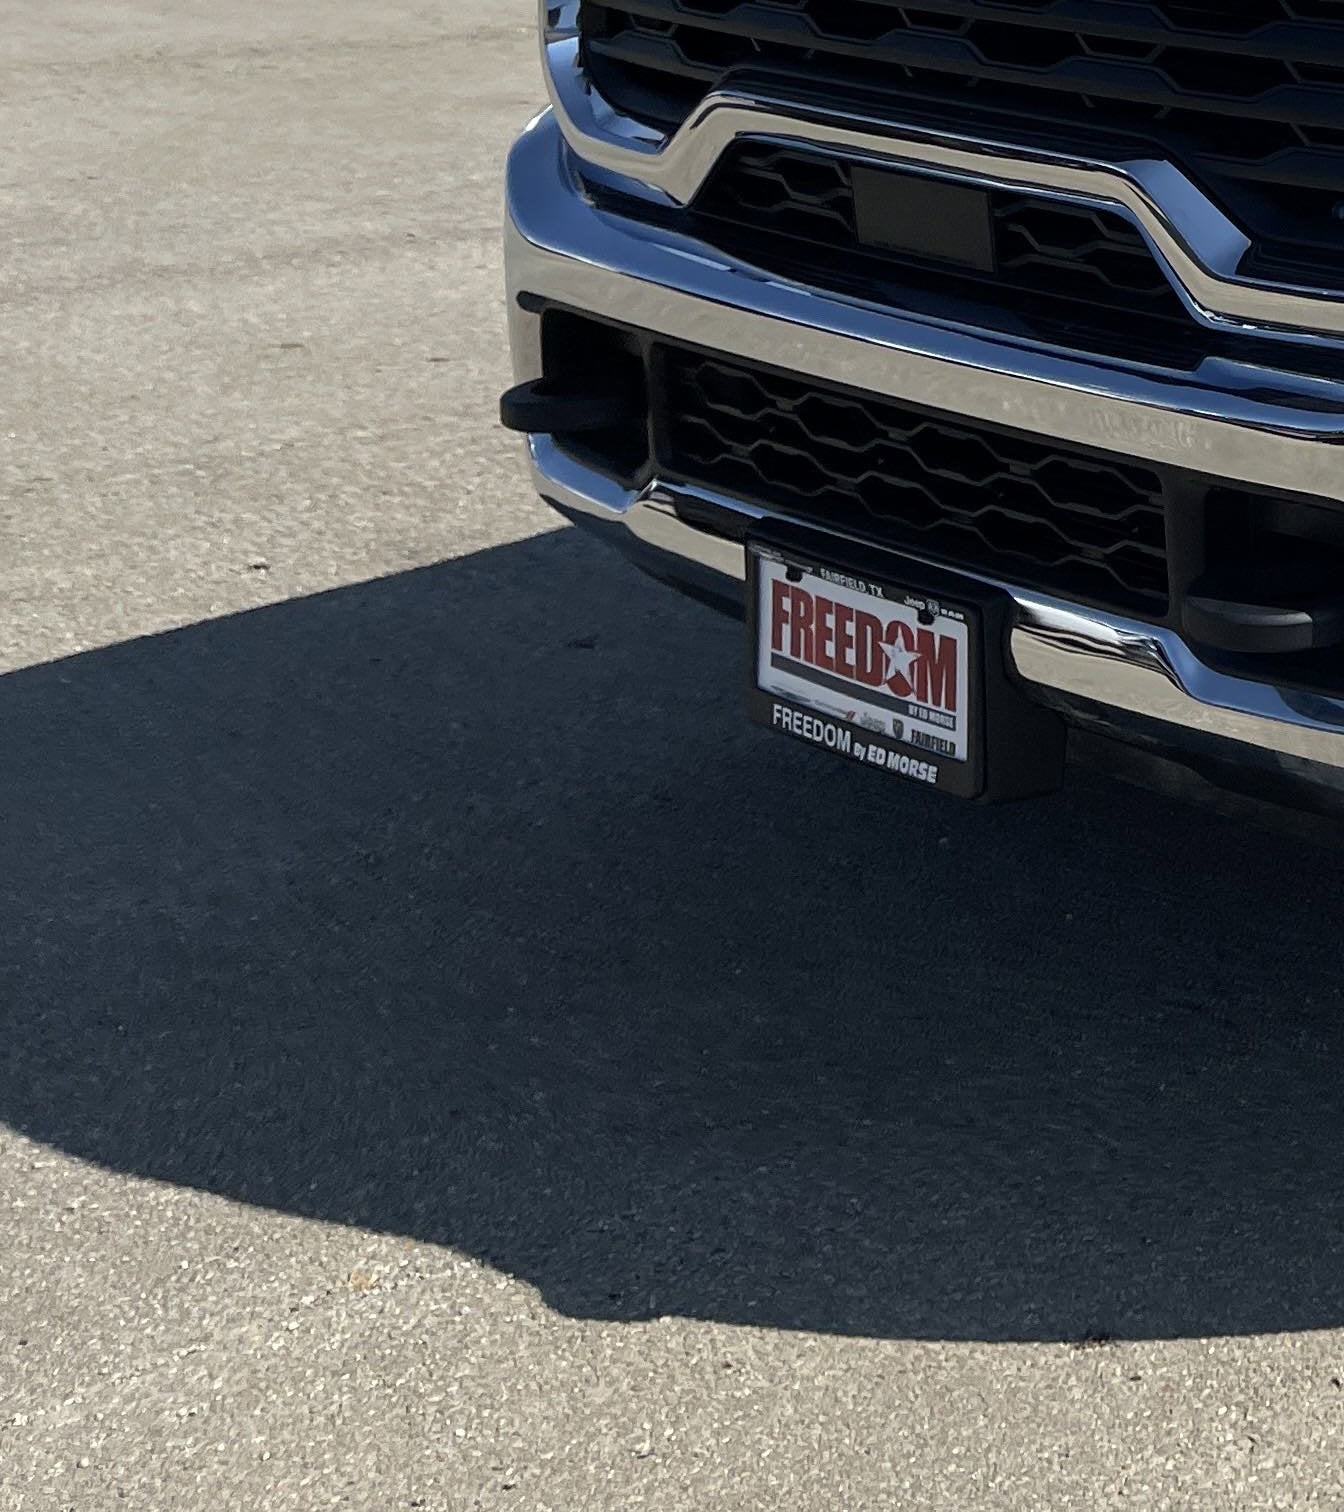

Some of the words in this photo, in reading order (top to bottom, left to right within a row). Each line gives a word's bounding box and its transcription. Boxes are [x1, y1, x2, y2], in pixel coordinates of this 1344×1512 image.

[770, 578, 958, 713] FREEDOM
[773, 703, 852, 753] FREEDOM
[867, 743, 886, 767] ED
[887, 751, 939, 784] MORSE
[910, 729, 956, 757] FAIRFIELD
